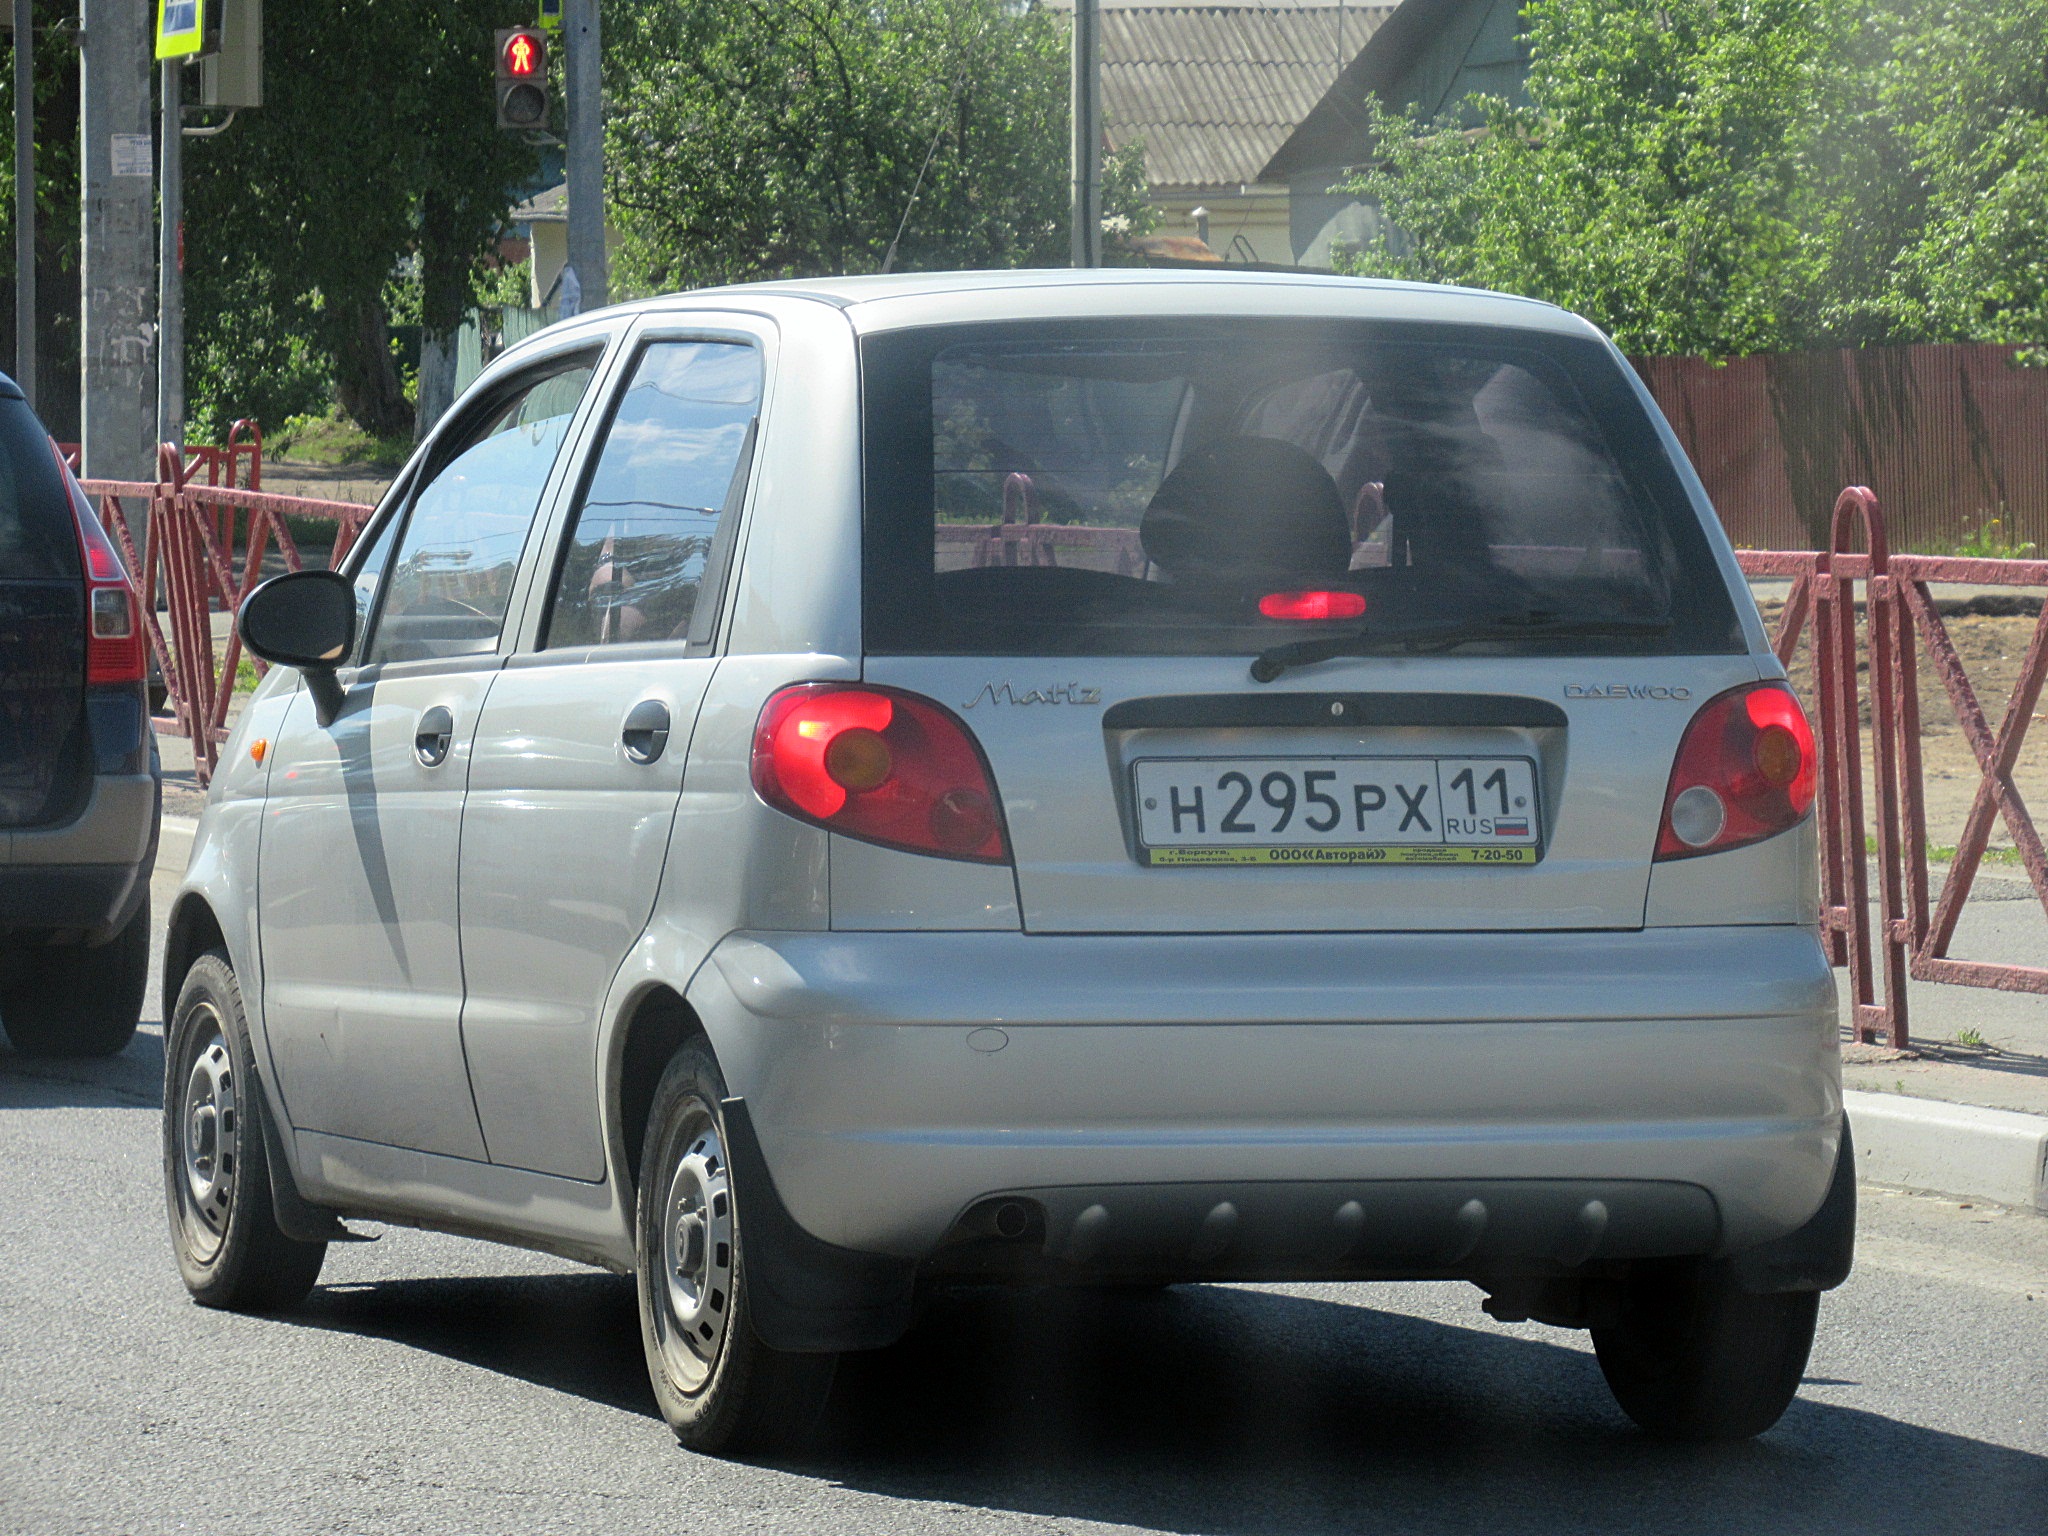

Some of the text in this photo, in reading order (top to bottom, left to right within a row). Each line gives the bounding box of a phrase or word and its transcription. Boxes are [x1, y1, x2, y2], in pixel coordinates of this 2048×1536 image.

[961, 679, 1101, 709] Matiz
[1563, 683, 1692, 701] DAEWOO
[1450, 767, 1510, 815] 11
[1447, 818, 1493, 835] RUS
[1471, 849, 1523, 861] 7-20-50
